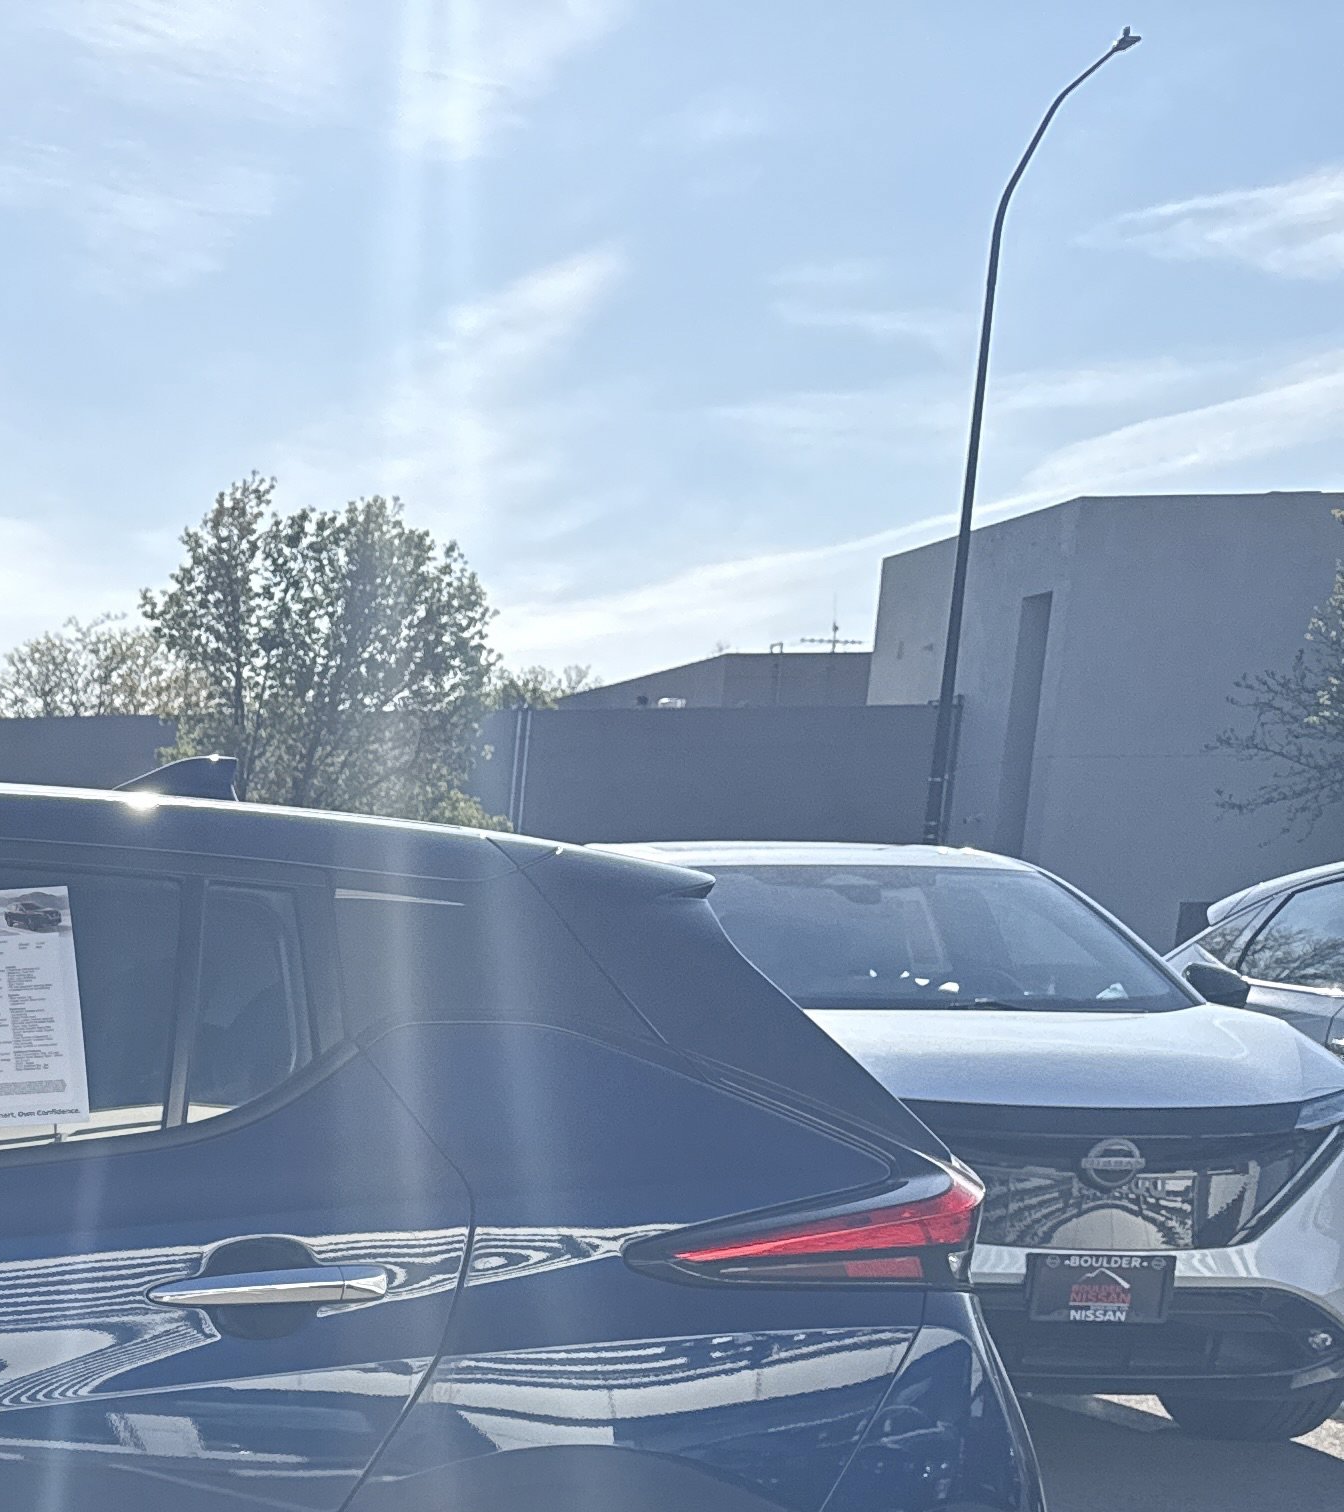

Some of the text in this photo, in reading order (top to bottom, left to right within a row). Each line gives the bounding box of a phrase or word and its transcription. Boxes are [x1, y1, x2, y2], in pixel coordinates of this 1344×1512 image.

[1070, 1255, 1141, 1268] BOULDER
[1071, 1291, 1131, 1305] NISSAN
[1070, 1309, 1127, 1322] NISSAN
